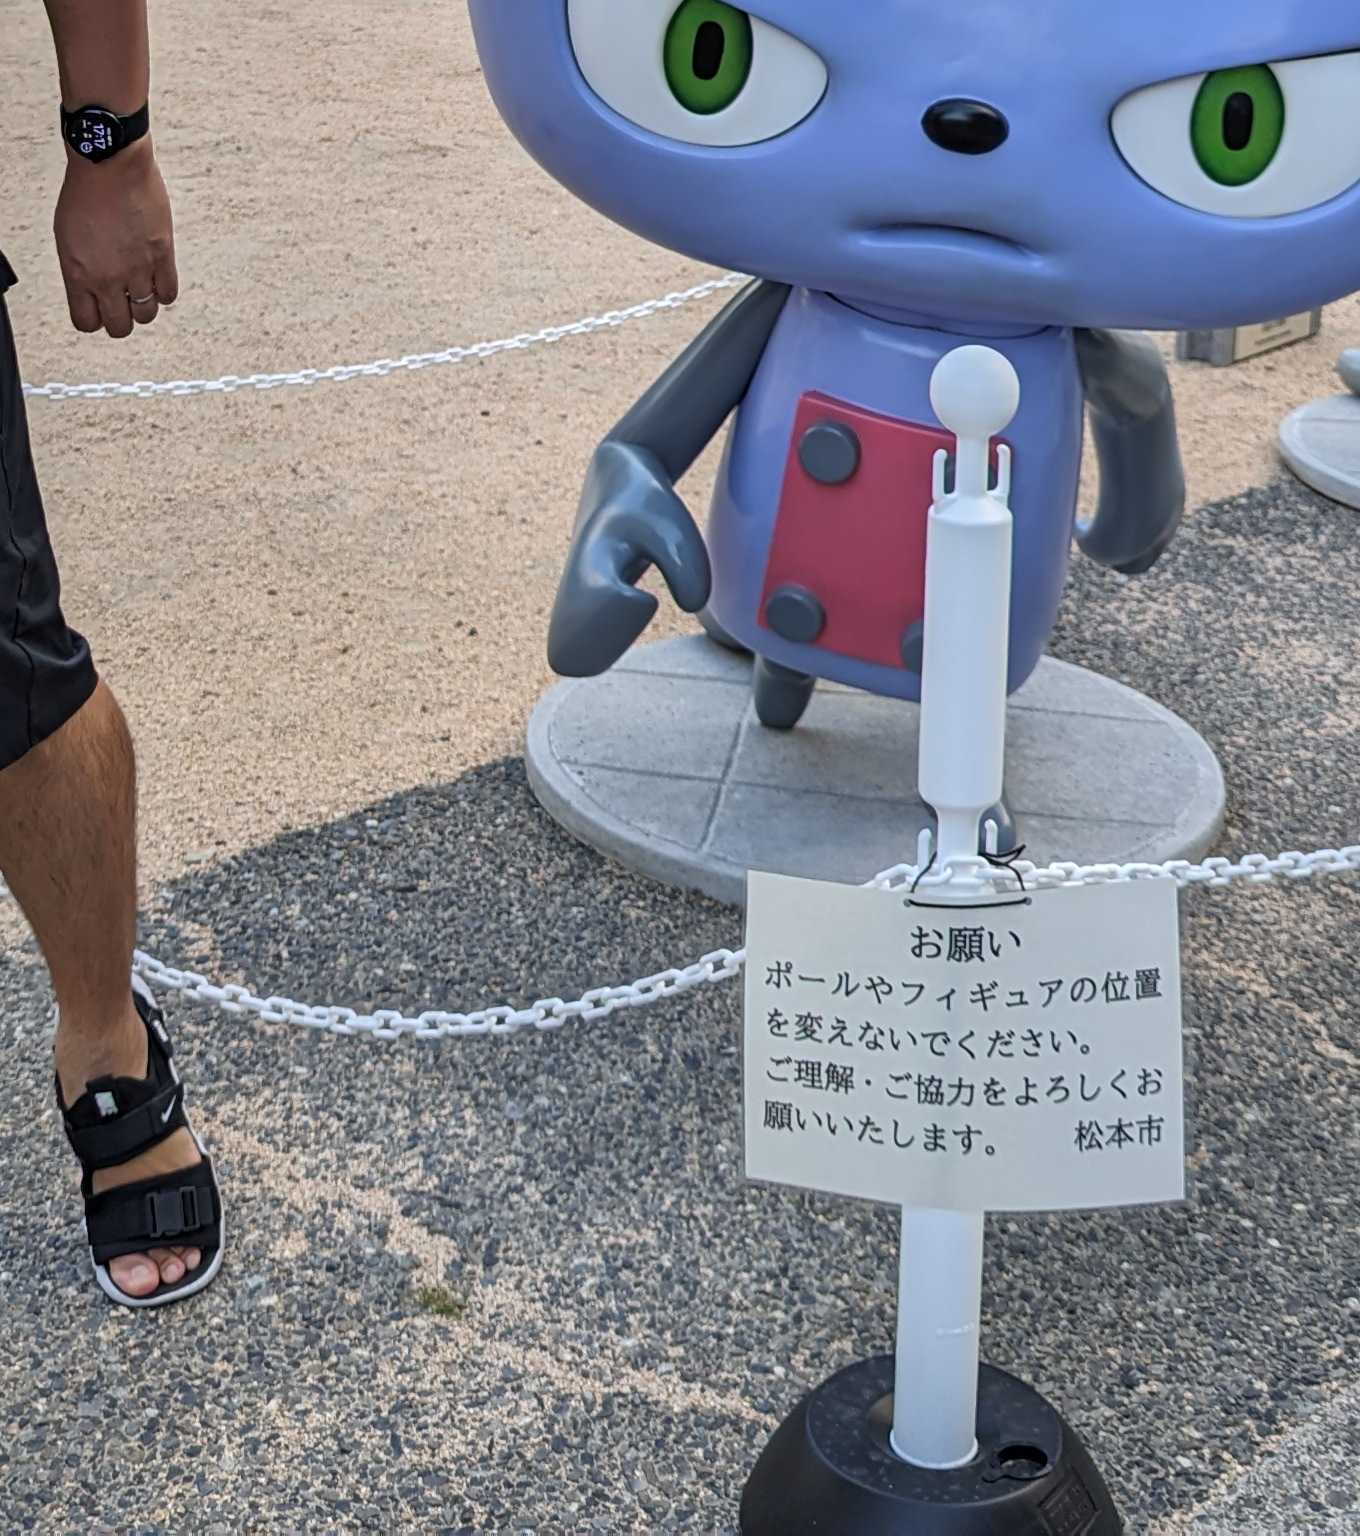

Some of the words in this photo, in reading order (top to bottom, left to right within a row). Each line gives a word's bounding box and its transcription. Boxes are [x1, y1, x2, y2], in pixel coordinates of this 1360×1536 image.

[94, 124, 106, 150] 17:17
[910, 926, 1022, 962] お願い
[765, 961, 1162, 1011] ポールやフィギュアの位置
[766, 1009, 1091, 1059] を変えないでください。
[766, 1055, 1163, 1107] ご理解・ご協力をよろしくお
[763, 1100, 997, 1156] 願いいたします。
[1074, 1114, 1165, 1152] 松本市
